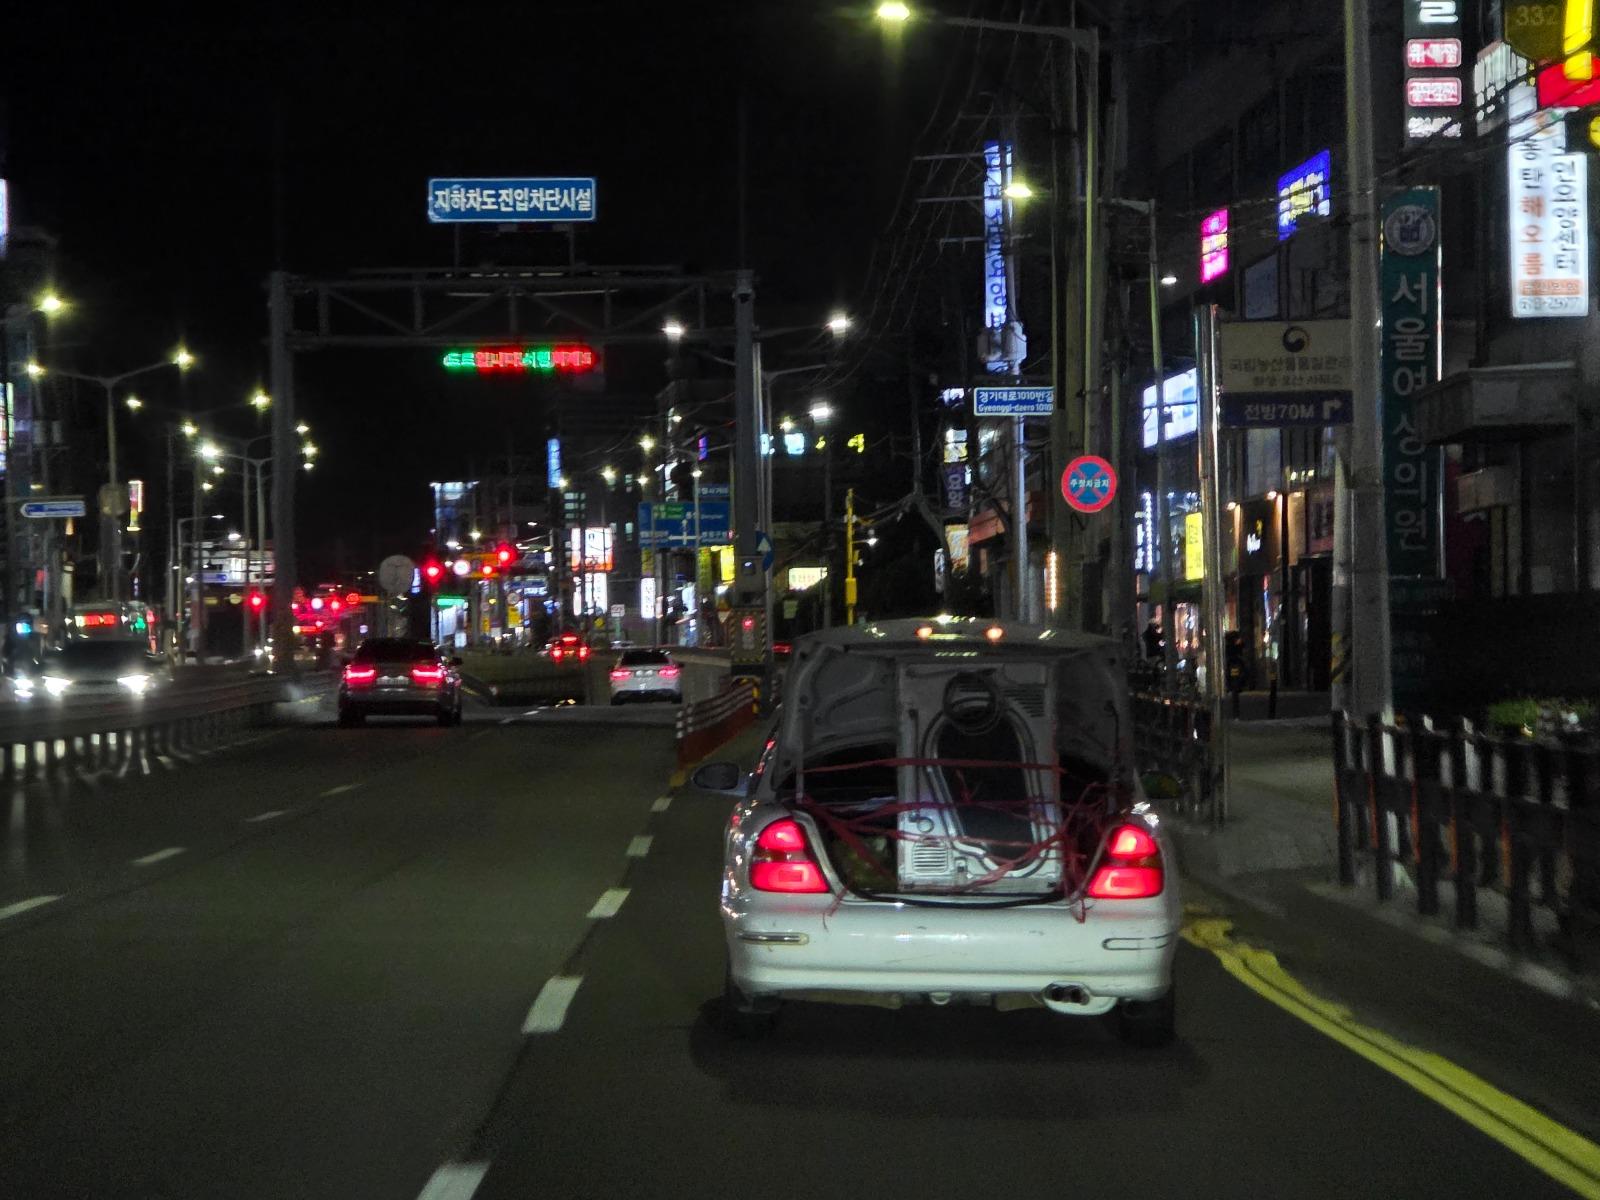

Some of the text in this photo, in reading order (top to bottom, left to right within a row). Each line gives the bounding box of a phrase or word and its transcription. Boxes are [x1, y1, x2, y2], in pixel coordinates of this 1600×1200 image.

[434, 186, 592, 212] 지하차도진입차단시설
[980, 391, 1054, 403] 경기대로1010번길
[1244, 403, 1315, 420] 전방70M
[1070, 478, 1110, 488] 주정차금지
